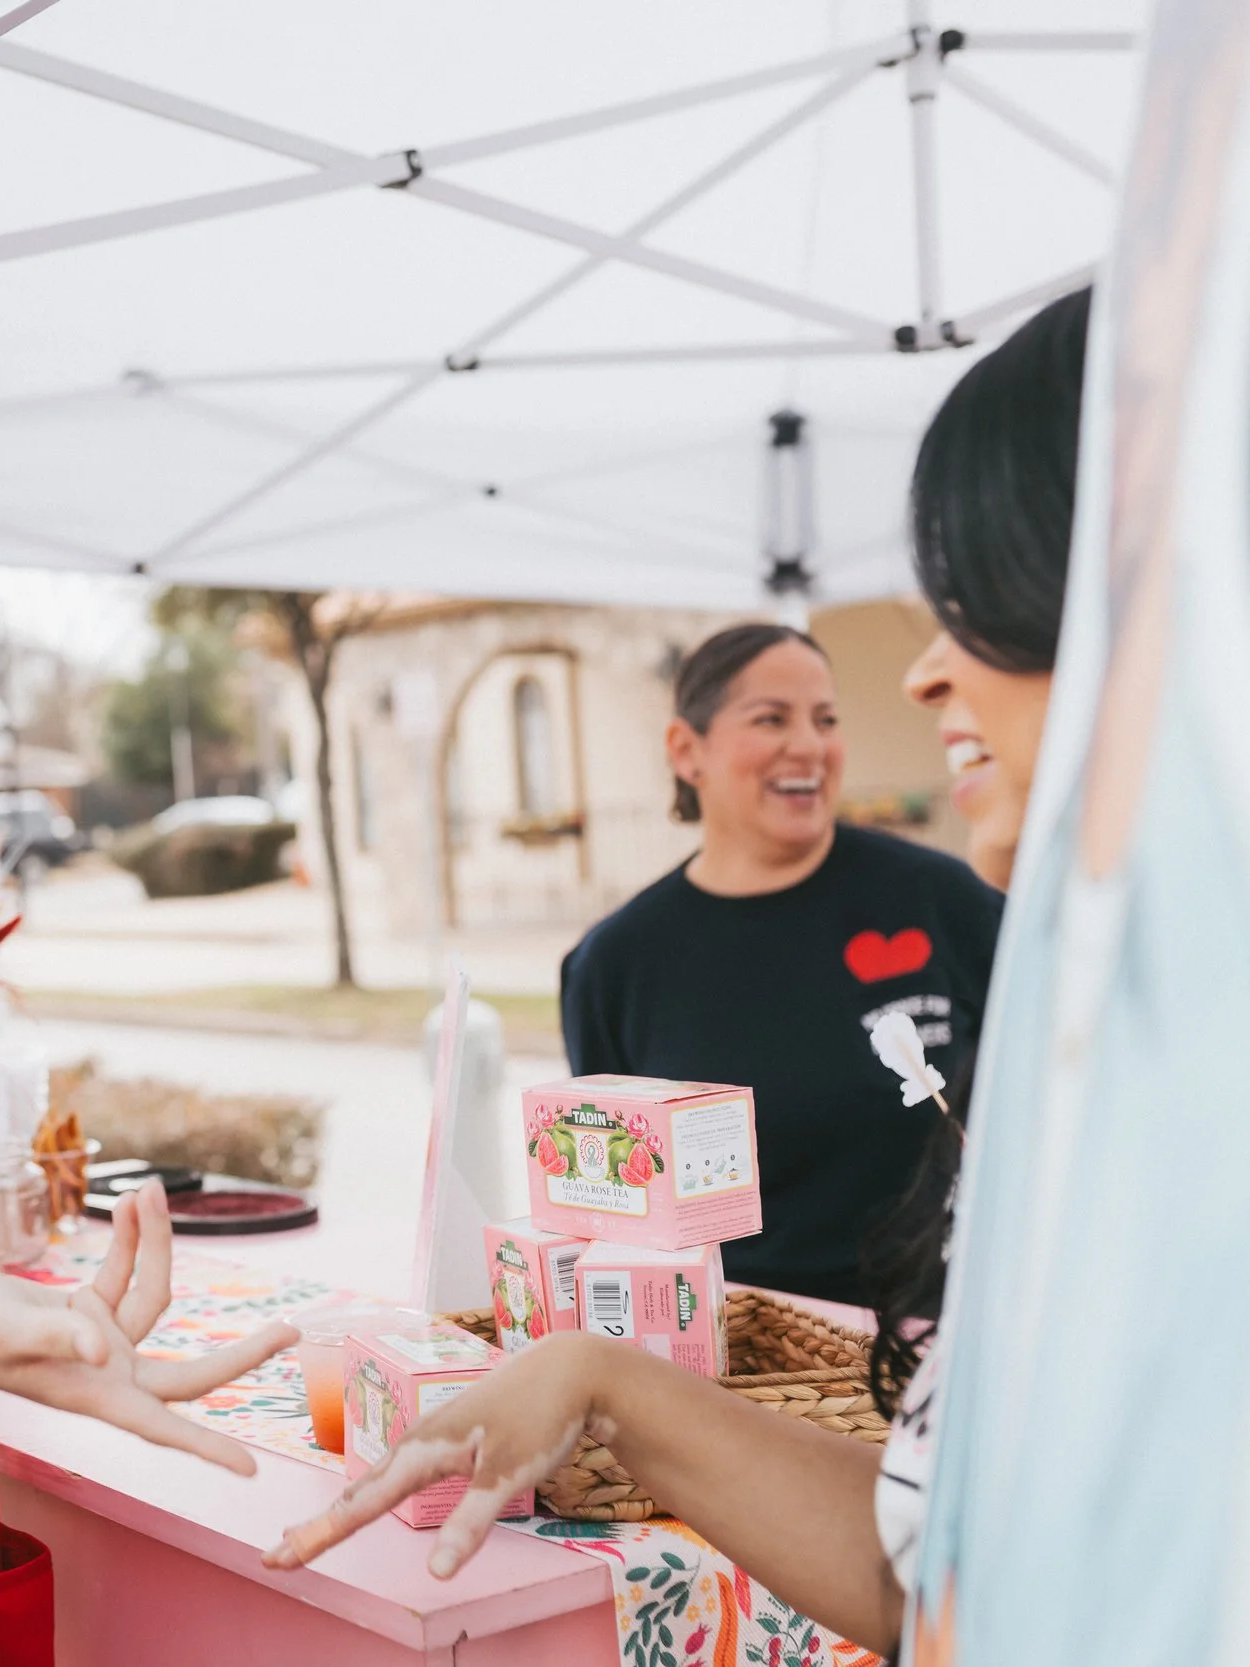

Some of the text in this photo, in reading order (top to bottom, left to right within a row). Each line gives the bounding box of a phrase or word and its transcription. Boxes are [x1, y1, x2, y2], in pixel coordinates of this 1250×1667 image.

[572, 1110, 607, 1127] TADIN
[562, 1181, 629, 1199] GUAVA ROSE TEA
[500, 1246, 523, 1266] TADIN
[677, 1283, 692, 1321] TADIN
